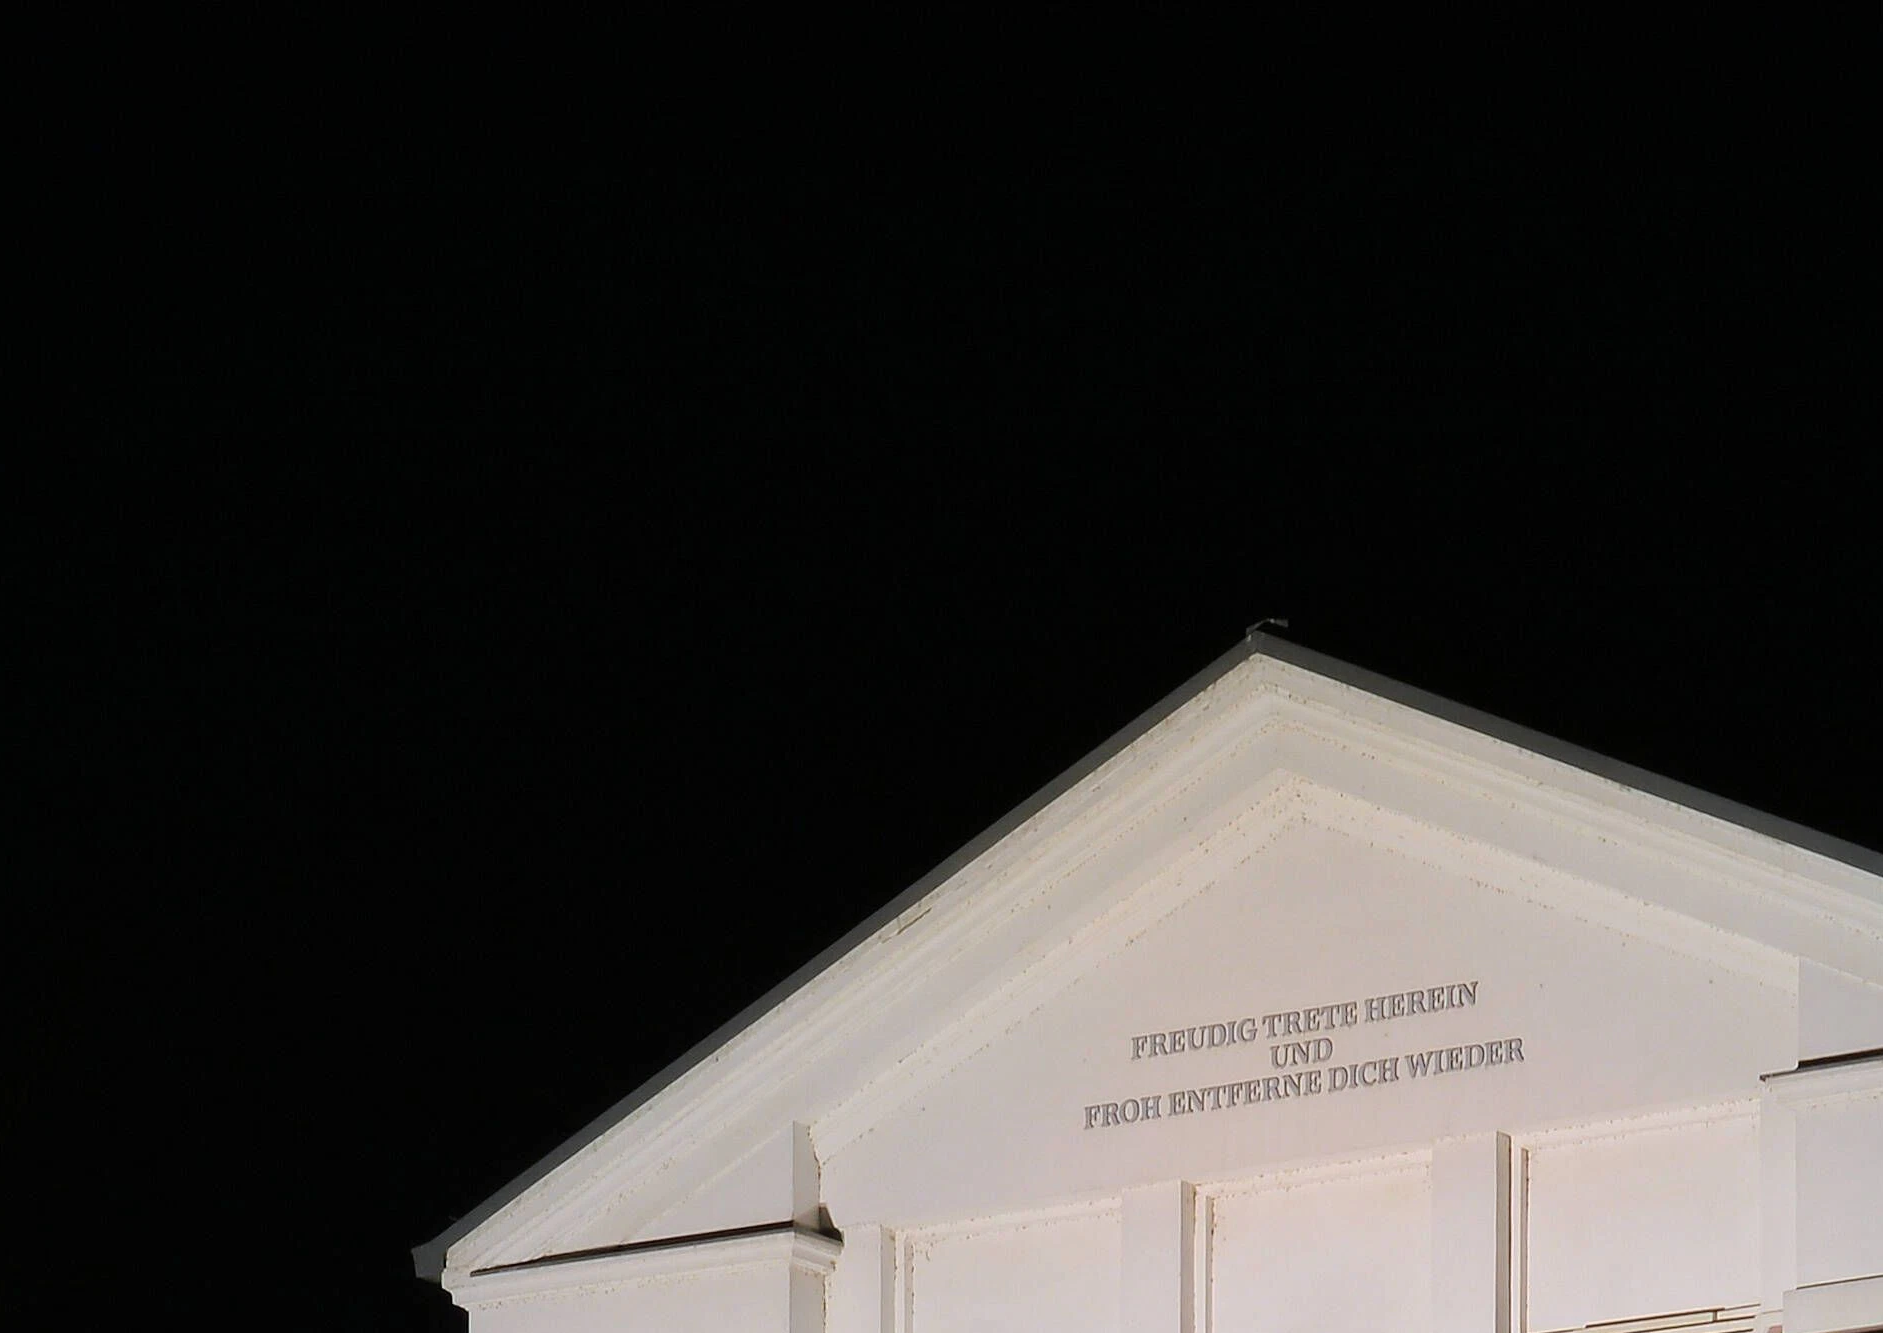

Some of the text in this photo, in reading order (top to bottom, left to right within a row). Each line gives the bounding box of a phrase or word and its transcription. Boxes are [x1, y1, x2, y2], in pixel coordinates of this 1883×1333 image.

[1131, 980, 1479, 1060] FREUDIG TRETE HEREIN
[1270, 1037, 1334, 1068] UND
[1083, 1037, 1526, 1129] FROH ENTFERNE DICH WIEDER
